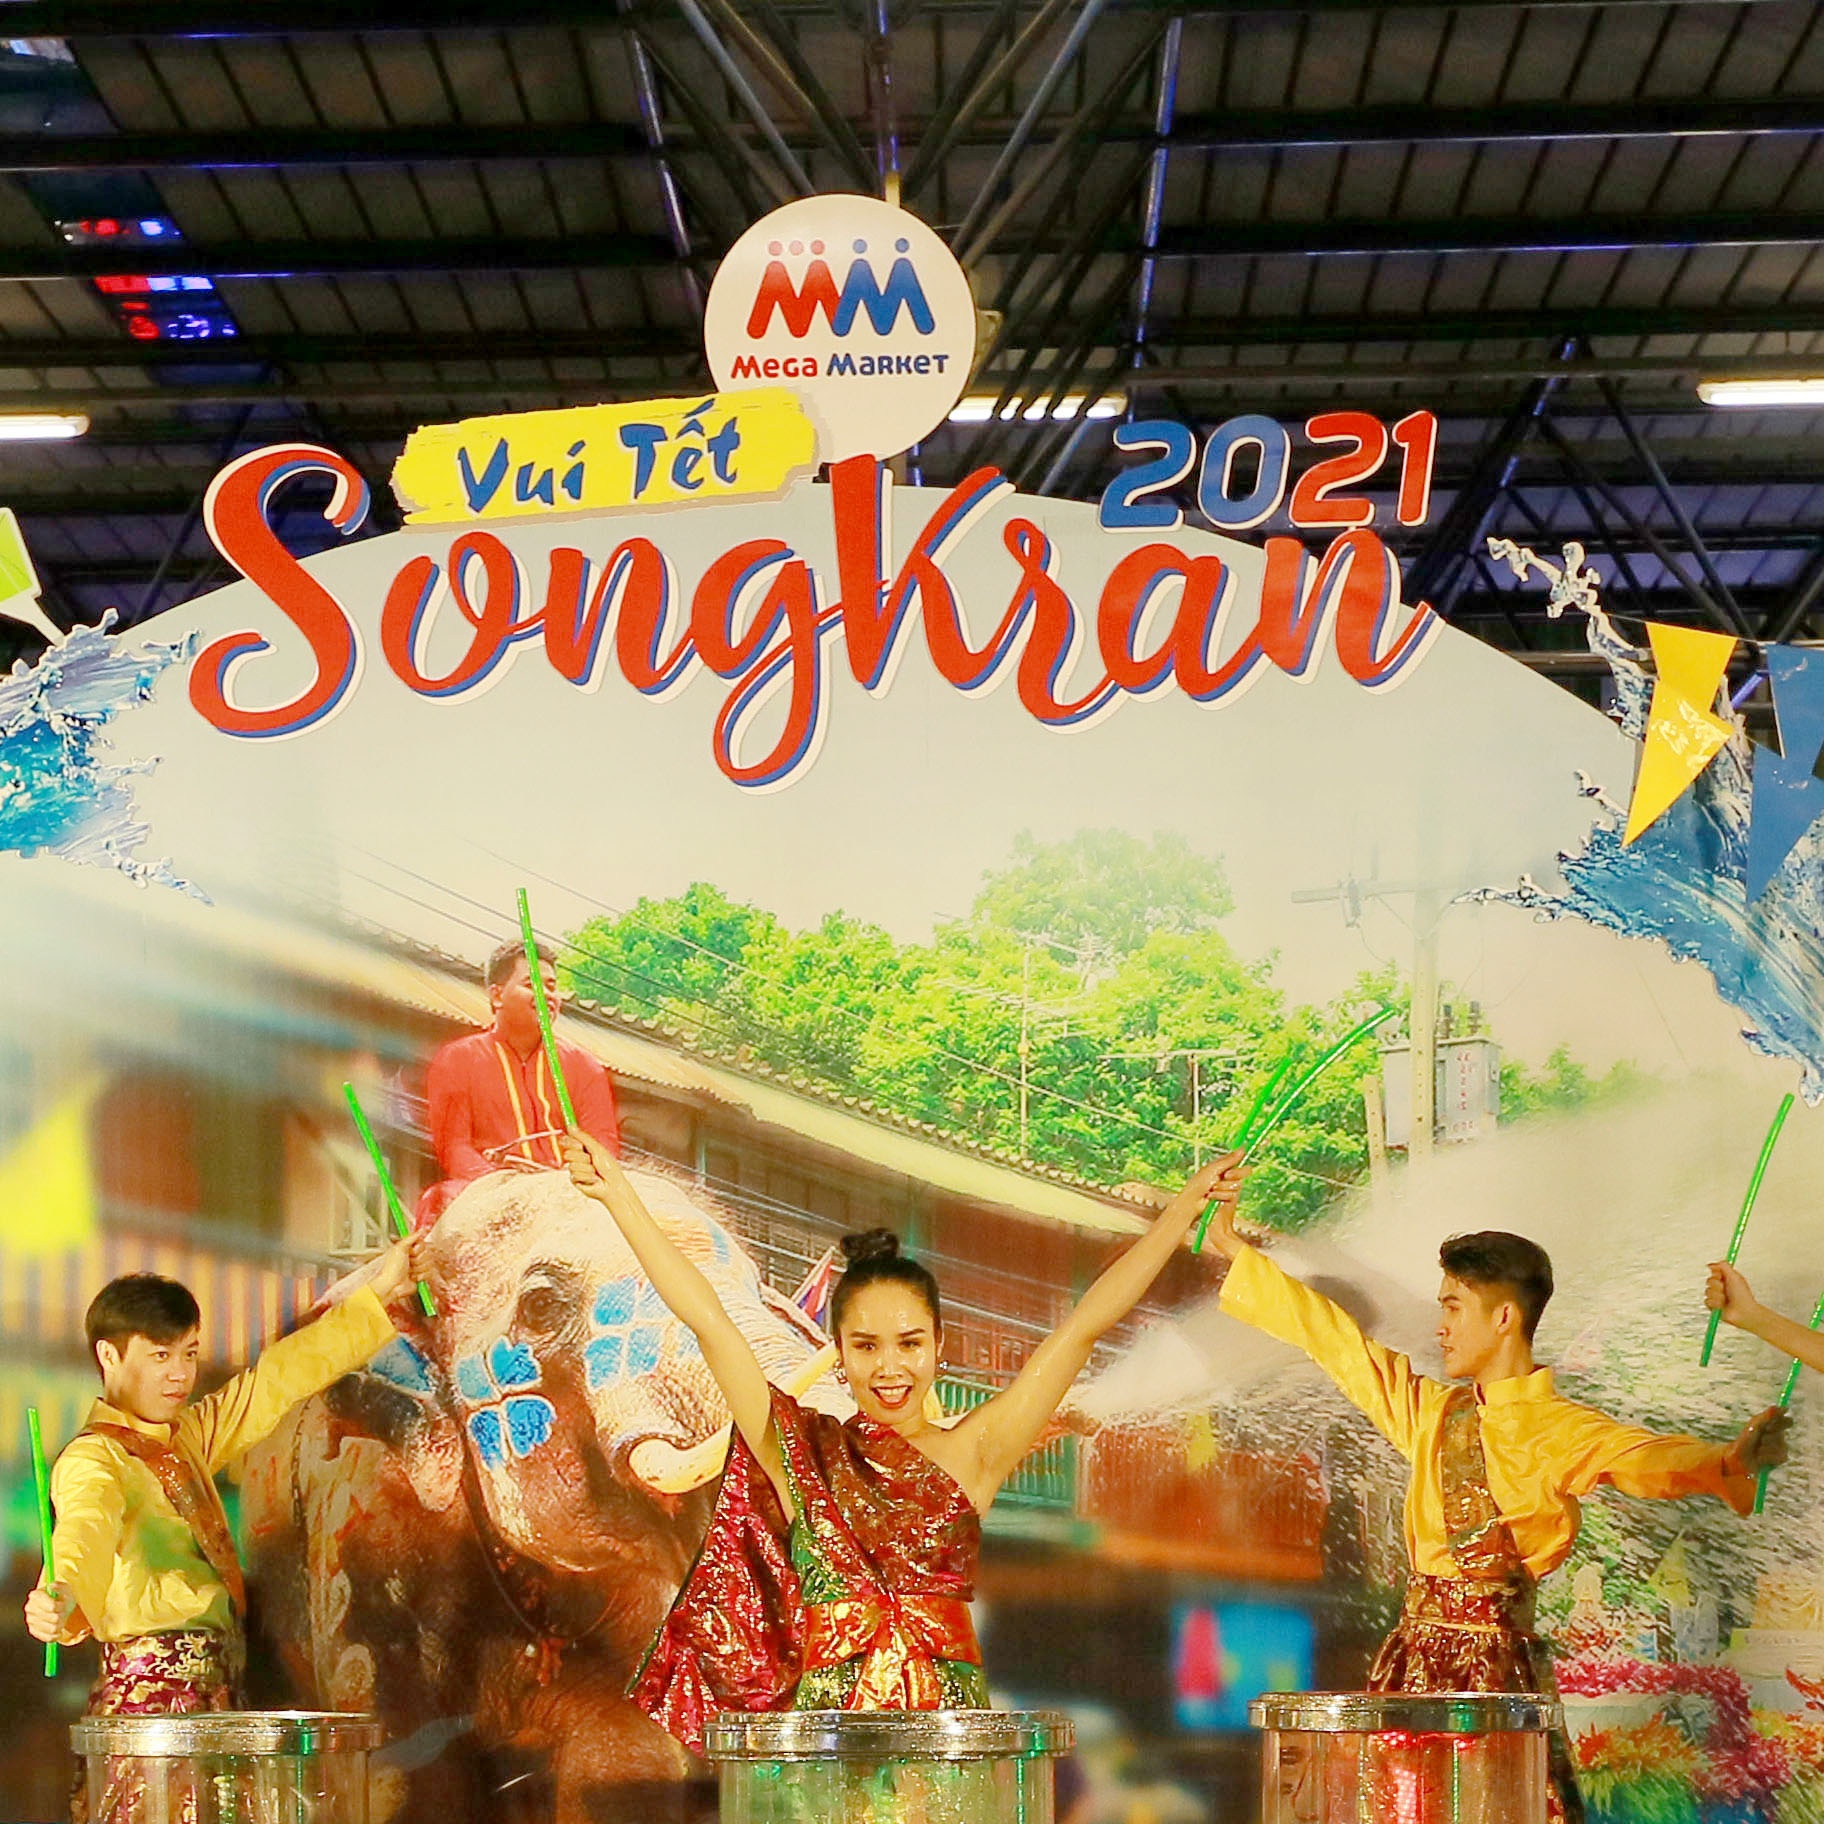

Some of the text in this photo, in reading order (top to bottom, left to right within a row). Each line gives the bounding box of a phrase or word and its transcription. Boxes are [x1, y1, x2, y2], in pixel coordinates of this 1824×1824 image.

[457, 397, 741, 513] Vui Tết
[1098, 410, 1437, 530] 2021
